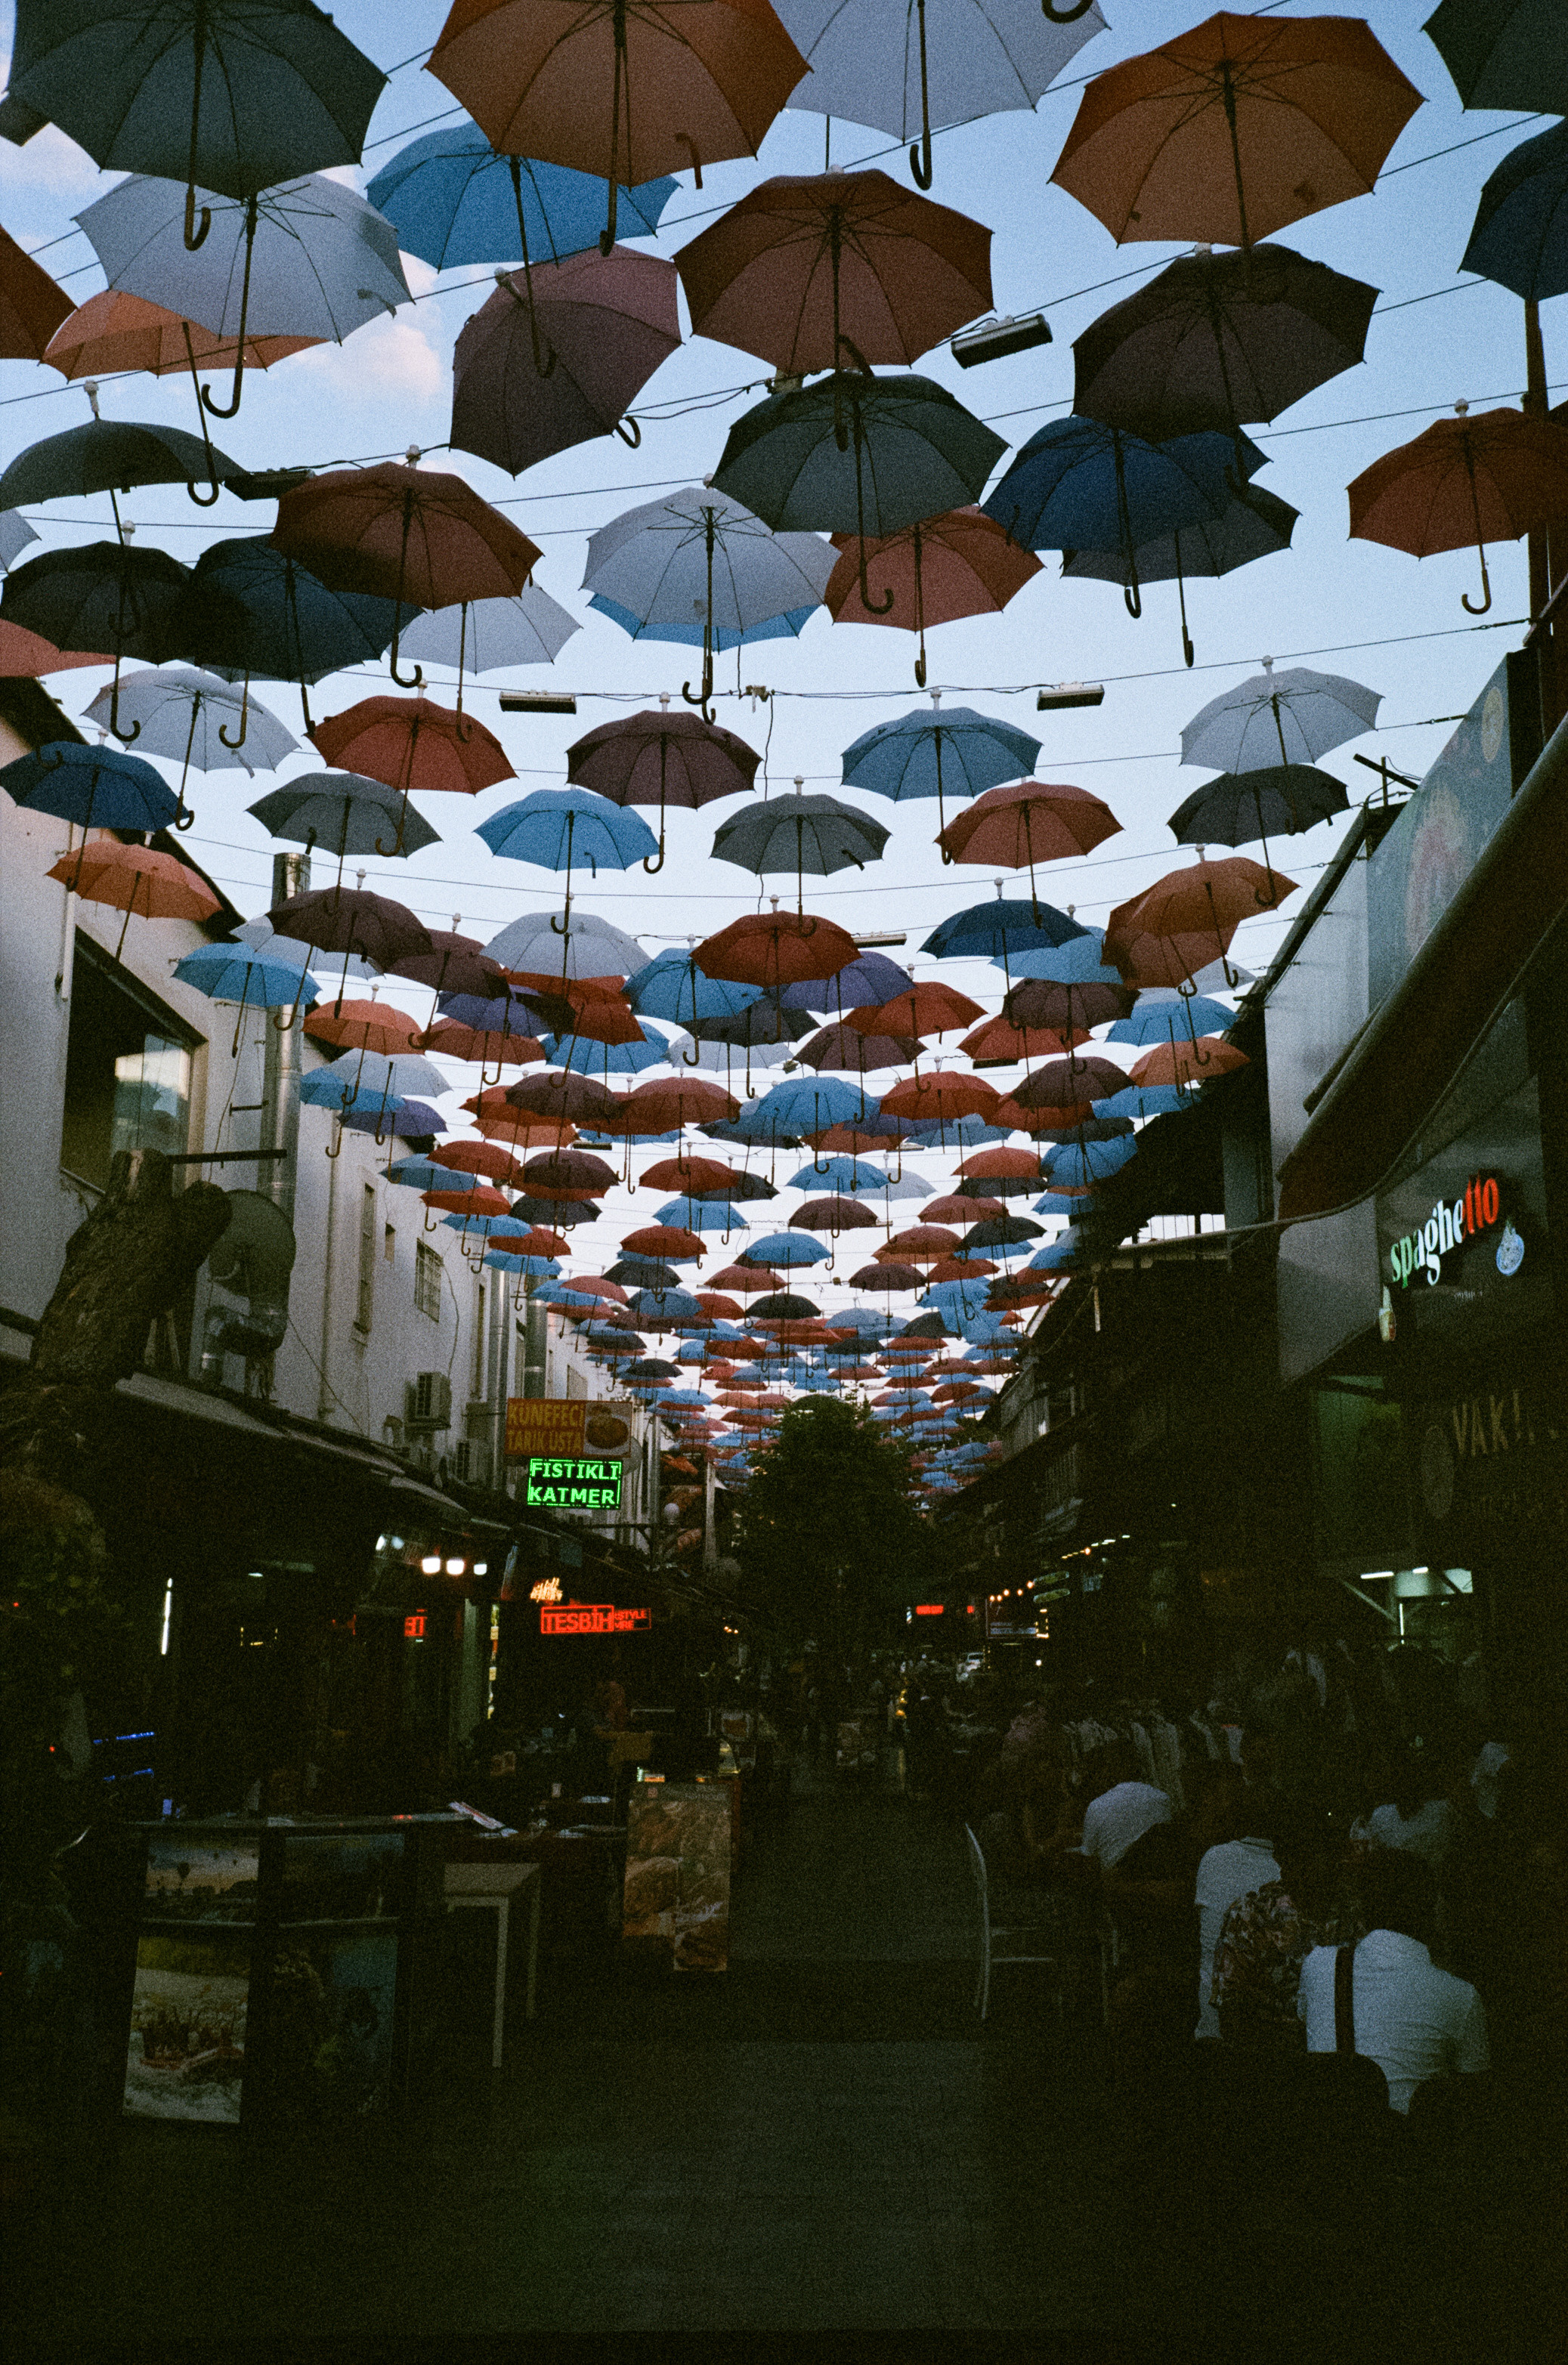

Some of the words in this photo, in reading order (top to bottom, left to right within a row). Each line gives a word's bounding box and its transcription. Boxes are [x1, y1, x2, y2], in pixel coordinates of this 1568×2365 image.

[1390, 1172, 1499, 1289] spaghetto
[549, 1431, 583, 1453] USTA
[530, 1462, 618, 1480] FISTIKLI
[529, 1486, 616, 1504] KATMER
